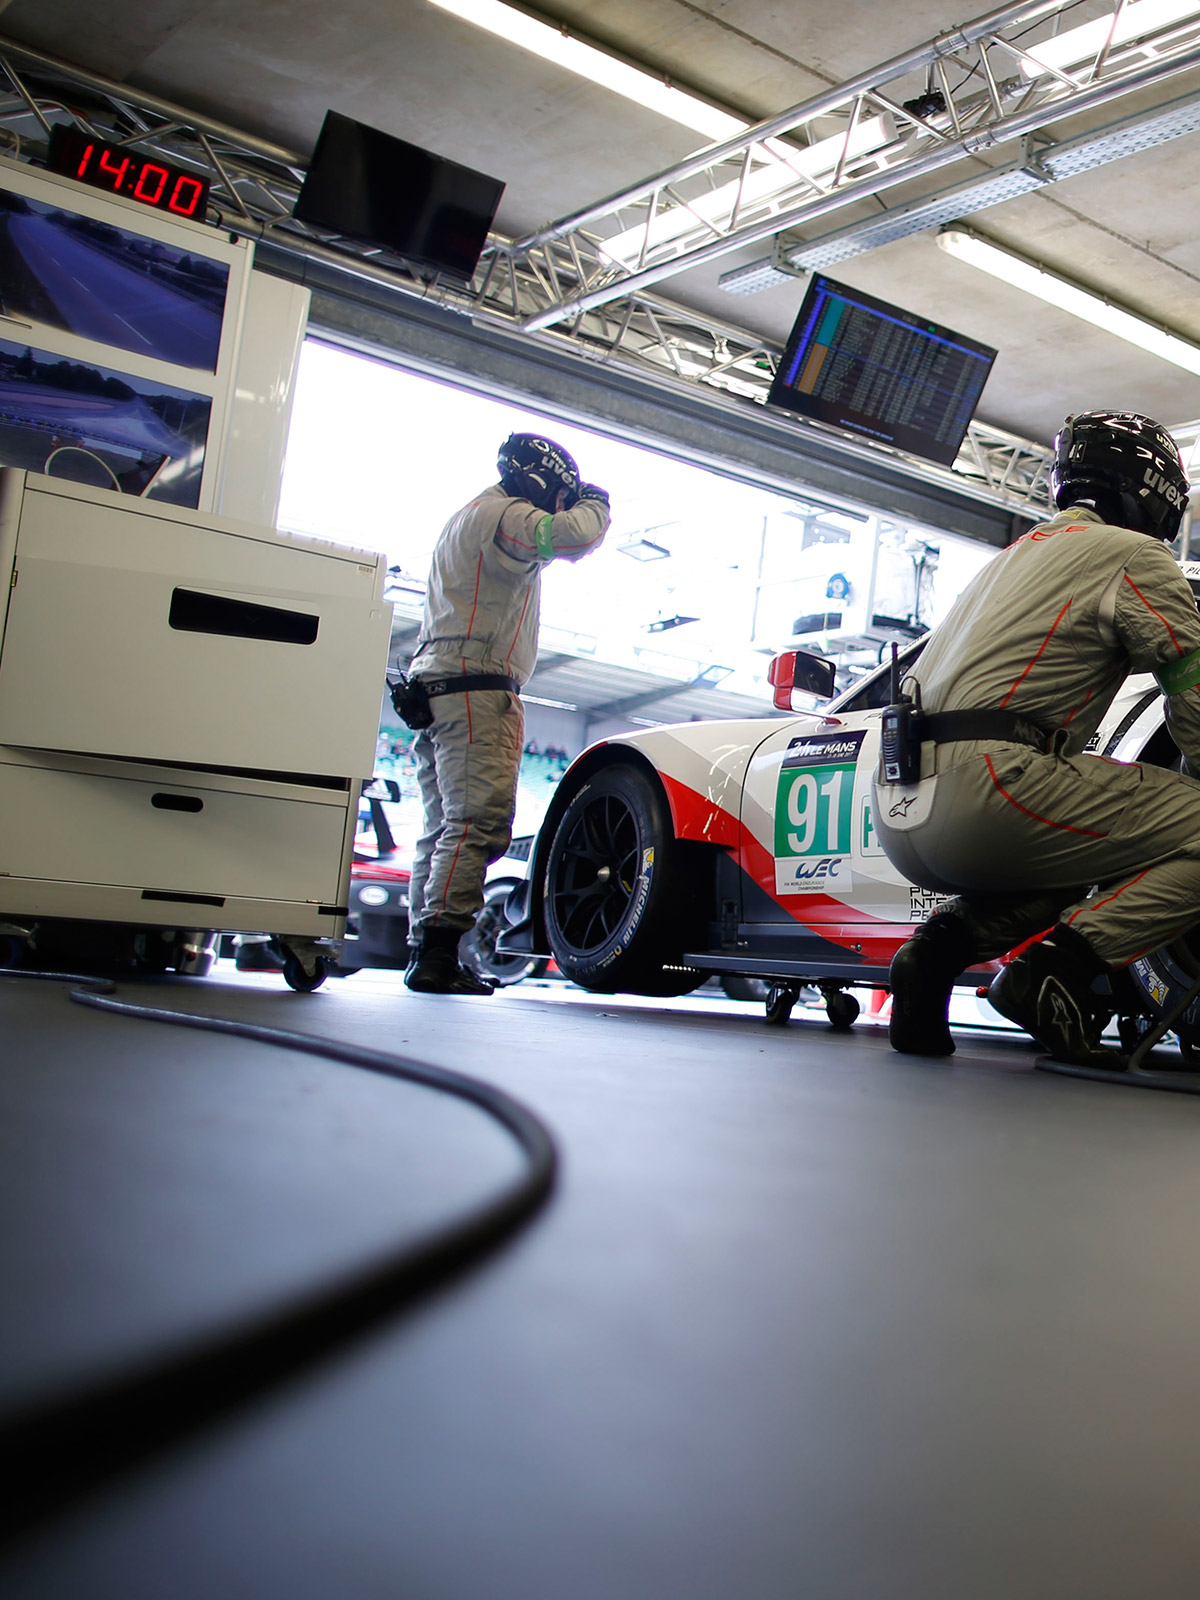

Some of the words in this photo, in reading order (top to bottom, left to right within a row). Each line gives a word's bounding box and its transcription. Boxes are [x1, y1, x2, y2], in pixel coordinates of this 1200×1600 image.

[77, 144, 203, 216] 14:00
[1143, 468, 1185, 511] uvex
[824, 740, 857, 754] MANS
[787, 770, 843, 853] 91
[795, 858, 842, 879] WEC
[623, 875, 650, 945] MICHELIN
